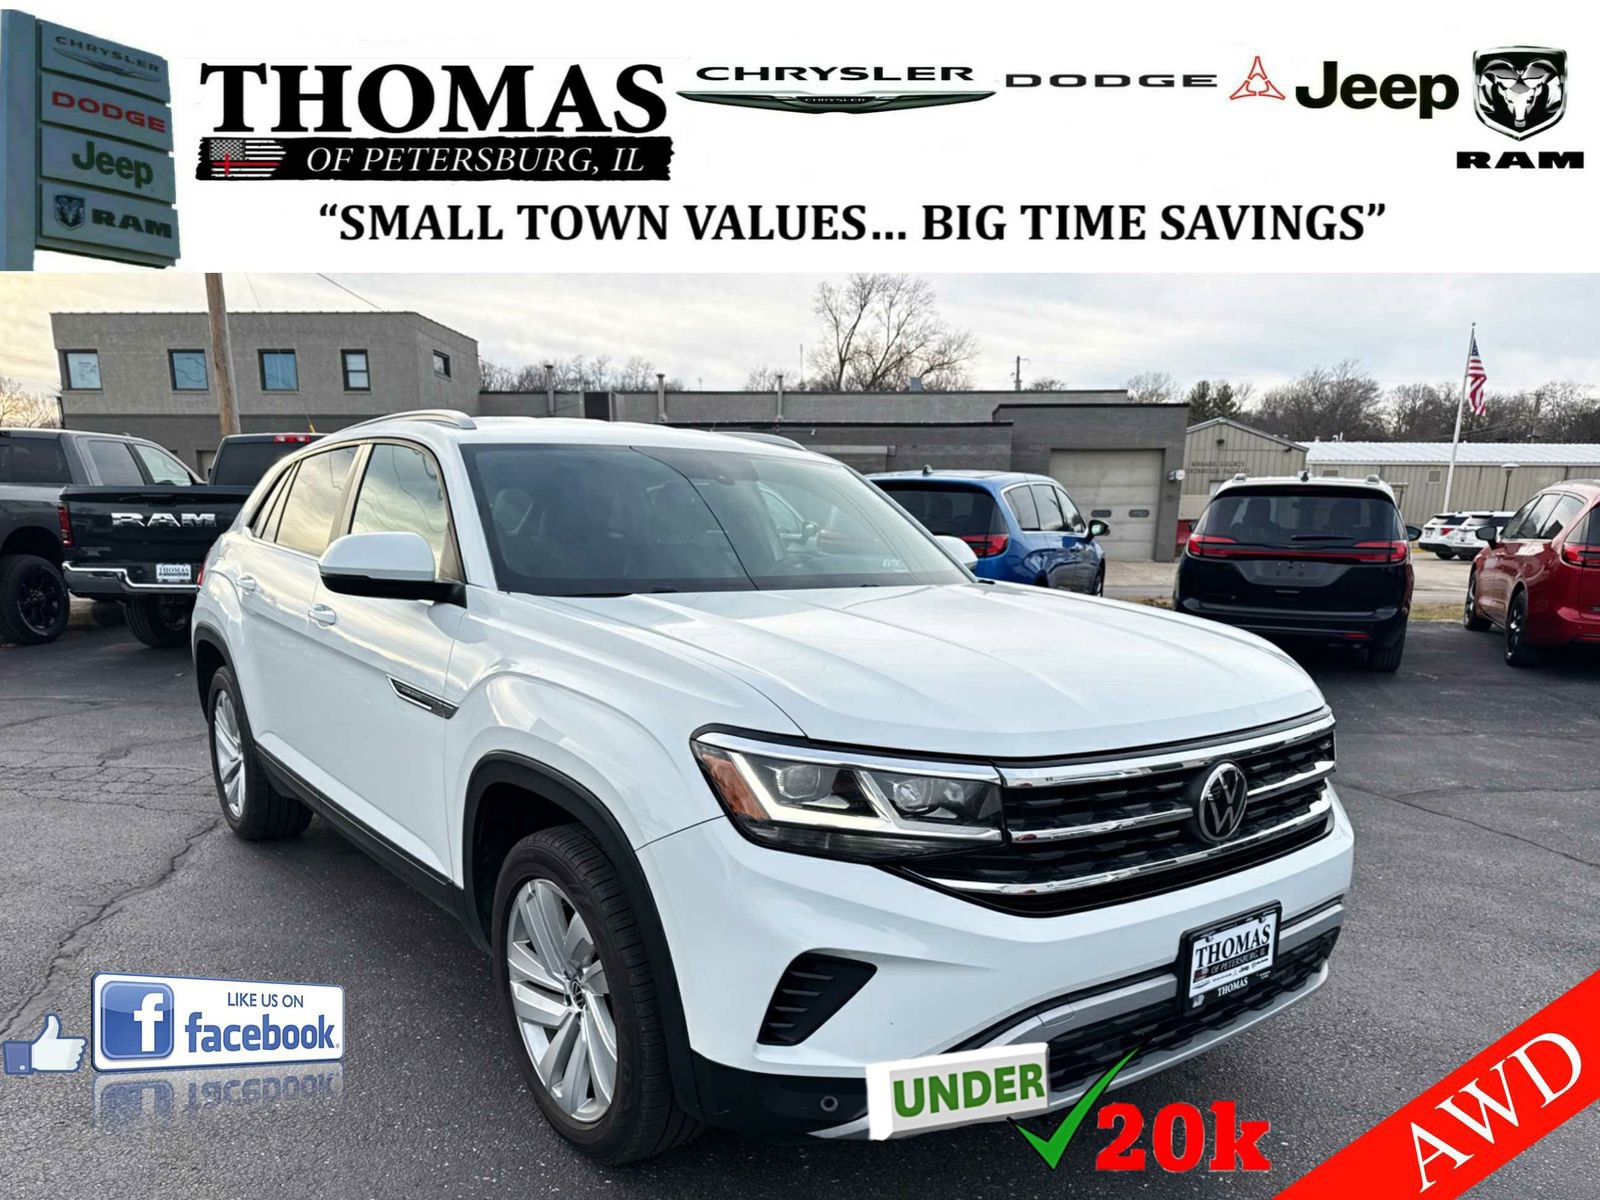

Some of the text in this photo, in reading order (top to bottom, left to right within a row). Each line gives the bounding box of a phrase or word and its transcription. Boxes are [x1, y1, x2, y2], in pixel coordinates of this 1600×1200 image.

[111, 513, 216, 527] RAM
[1195, 924, 1271, 969] THOMAS
[1217, 976, 1249, 997] THOMAS
